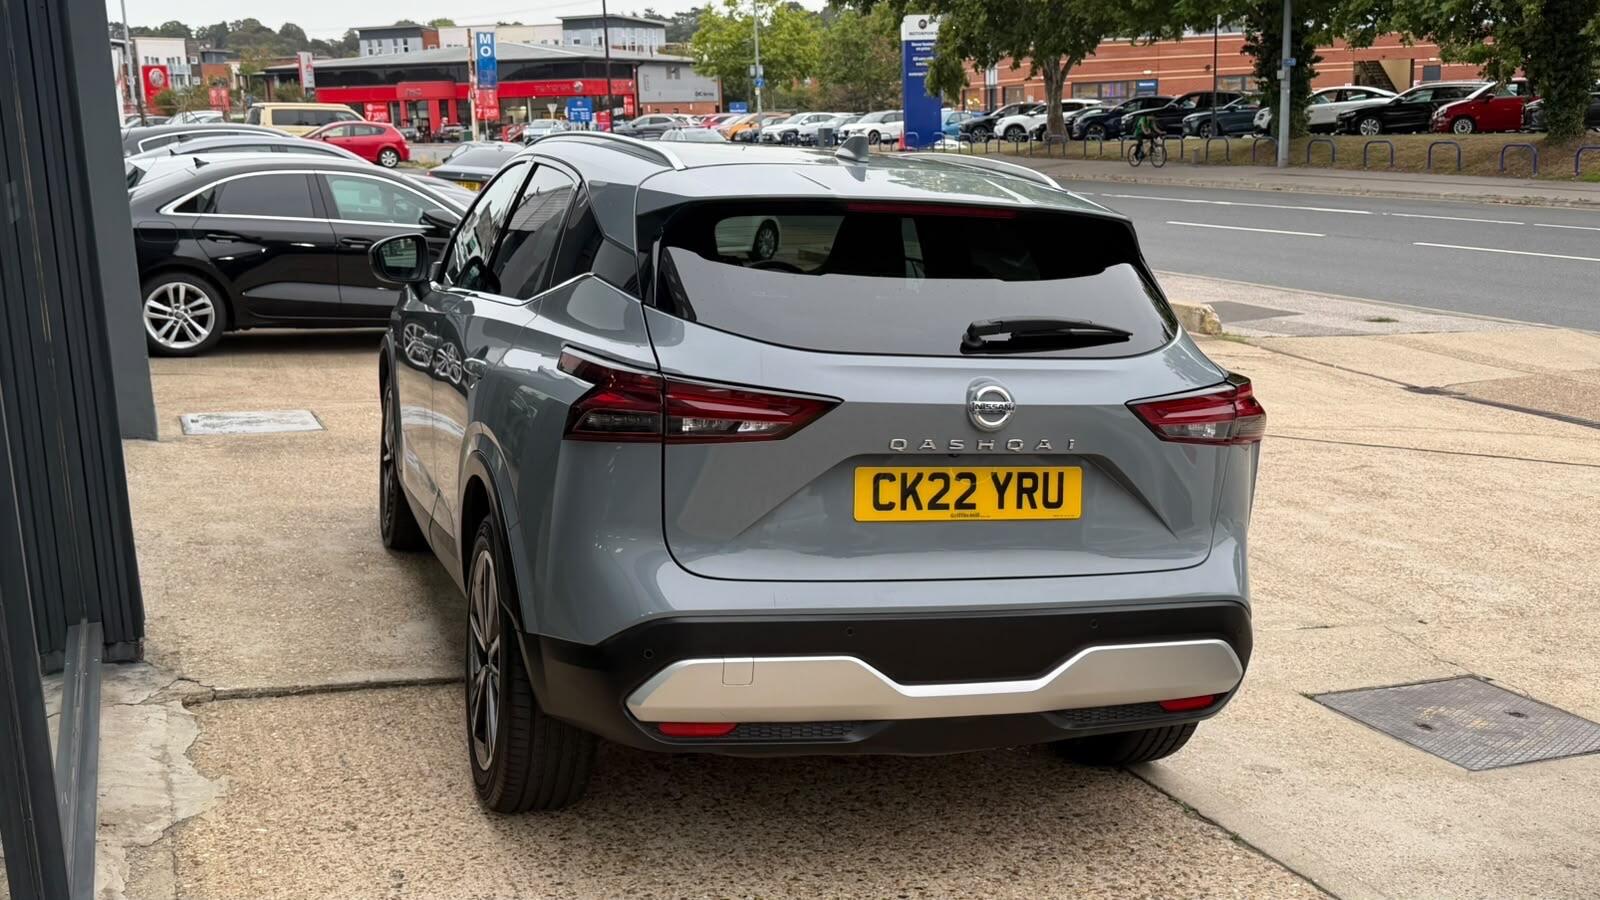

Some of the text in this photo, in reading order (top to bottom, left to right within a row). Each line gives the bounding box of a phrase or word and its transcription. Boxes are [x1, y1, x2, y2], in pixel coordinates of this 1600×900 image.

[975, 402, 1012, 411] NISSAN
[889, 438, 1076, 453] QASHQAI
[872, 471, 1065, 511] CK22 YRU
